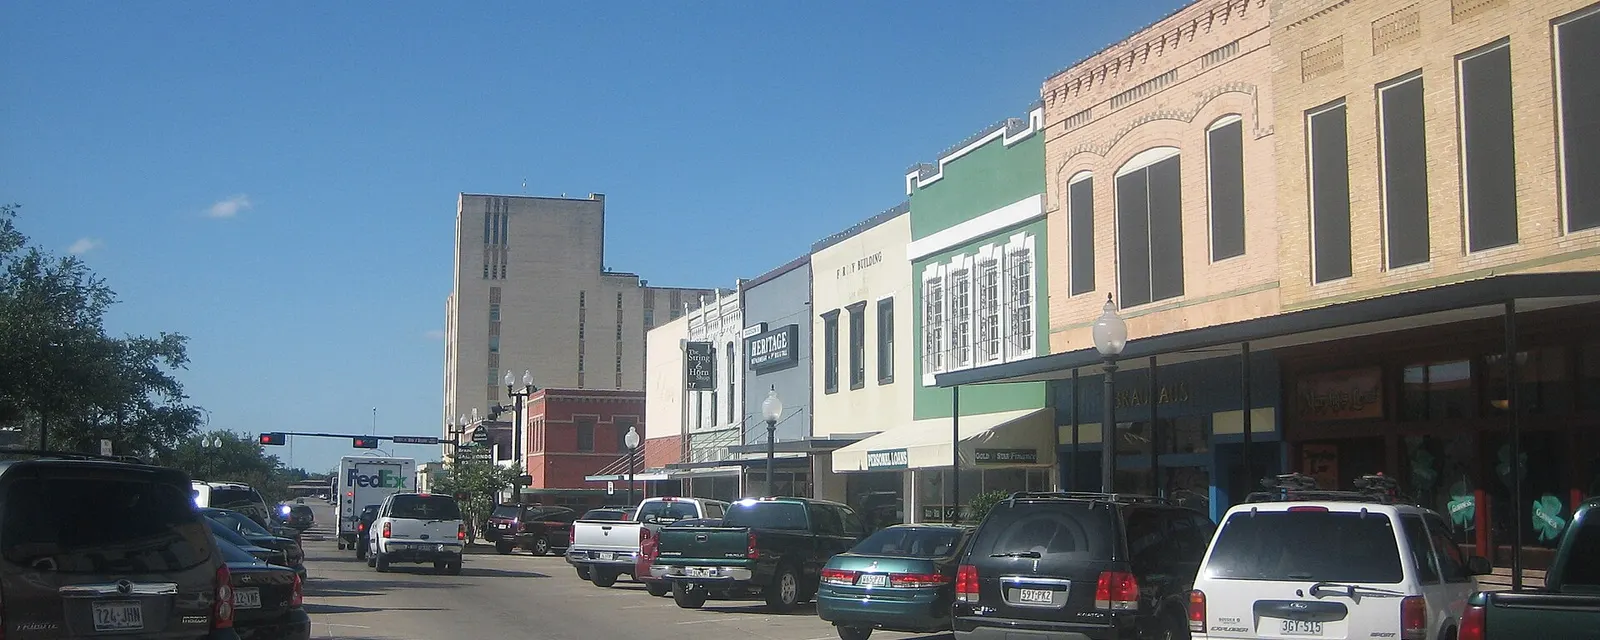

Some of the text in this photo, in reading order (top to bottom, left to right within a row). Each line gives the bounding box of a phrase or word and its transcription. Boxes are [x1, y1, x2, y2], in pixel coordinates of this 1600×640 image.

[857, 251, 882, 270] BUILDING
[751, 331, 788, 357] HERITAGE
[689, 354, 710, 363] String
[689, 368, 709, 376] Horn
[868, 451, 907, 467] PERSONAL LOANS
[976, 452, 990, 460] GOLD
[347, 468, 407, 488] FedEx
